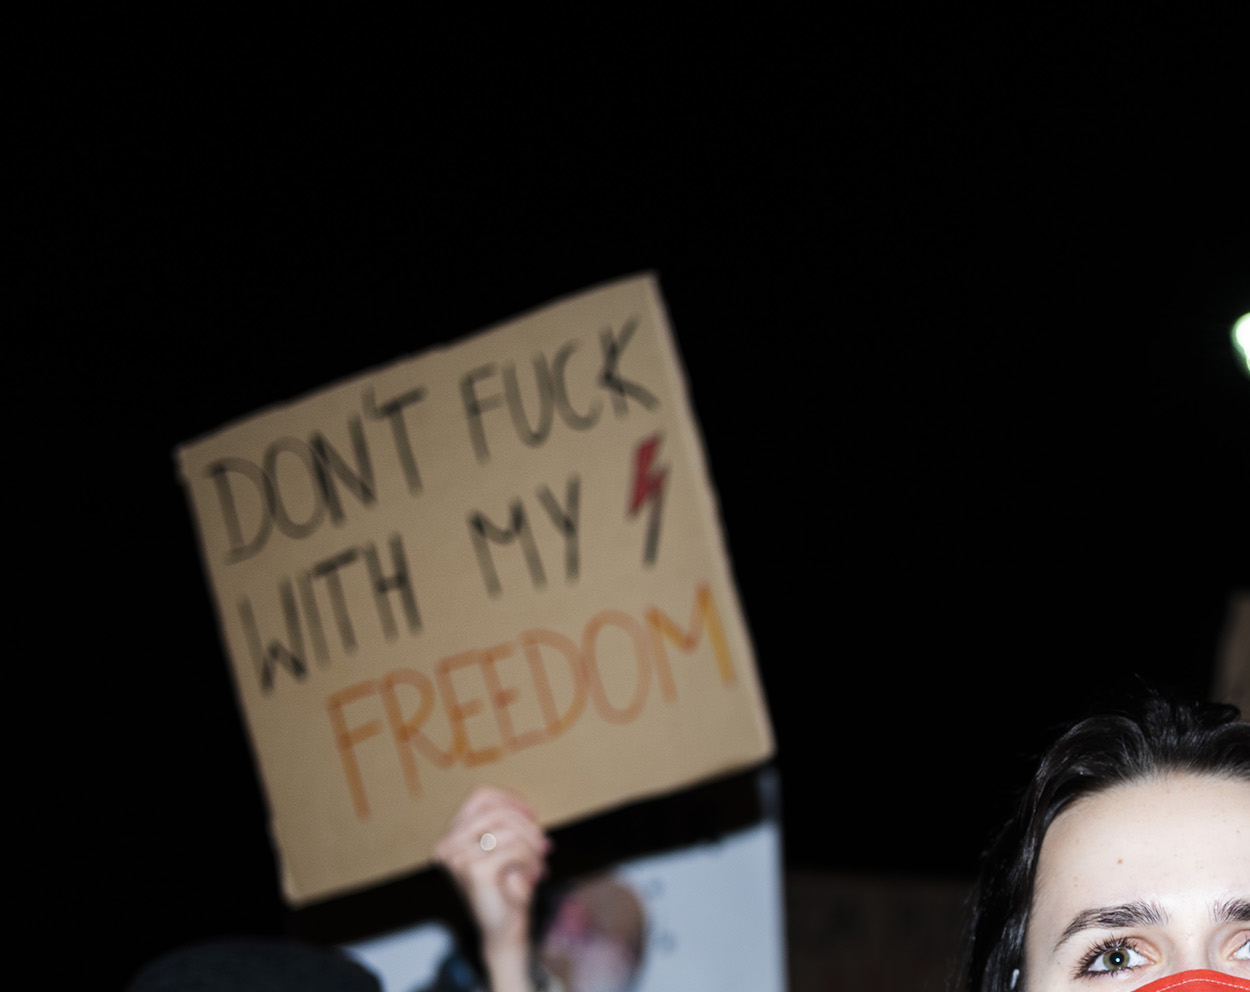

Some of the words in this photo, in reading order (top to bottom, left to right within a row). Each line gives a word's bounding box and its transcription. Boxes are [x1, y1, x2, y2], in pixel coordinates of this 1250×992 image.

[205, 382, 429, 566] DON'T
[459, 313, 661, 466] FUCK
[238, 530, 424, 697] WITH
[468, 471, 584, 599] MY
[327, 578, 740, 822] FREEDOM
